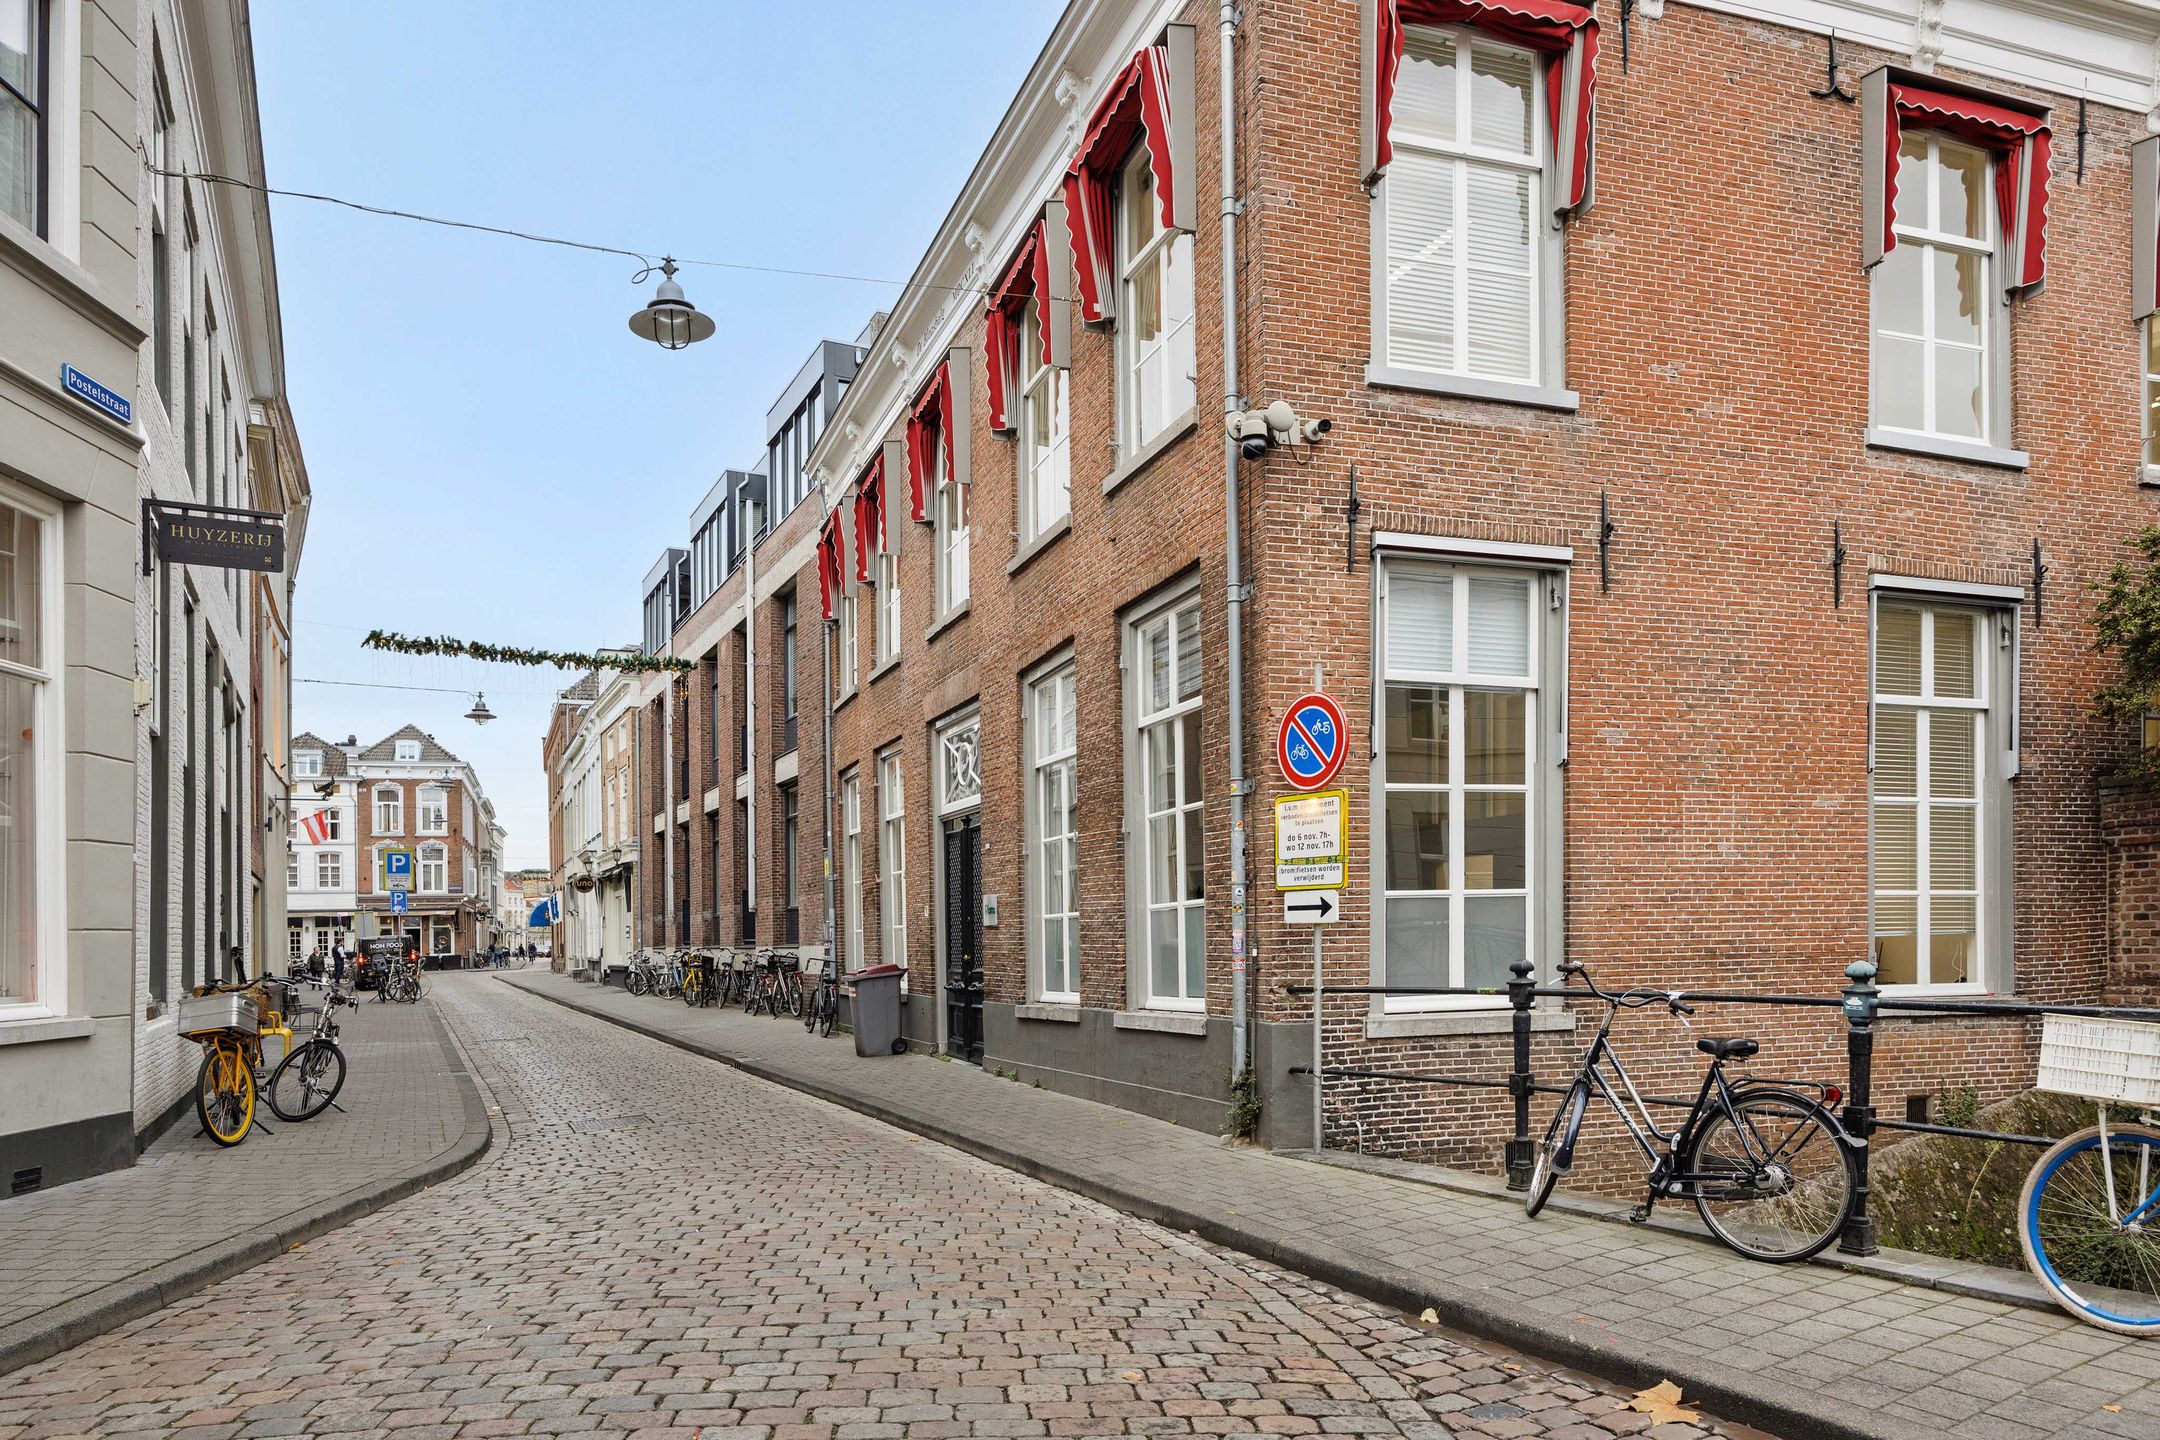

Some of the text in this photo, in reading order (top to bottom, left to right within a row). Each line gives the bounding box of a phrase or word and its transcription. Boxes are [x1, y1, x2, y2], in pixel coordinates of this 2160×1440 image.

[70, 372, 129, 416] Postelstraat
[171, 524, 272, 547] HUYZERIJ
[1287, 834, 1296, 842] do
[1297, 833, 1302, 841] 6
[1303, 833, 1318, 841] nov.
[1322, 840, 1334, 848] 17h
[392, 855, 406, 872] P
[1318, 864, 1340, 872] worden
[1294, 874, 1325, 882] verwijderd
[394, 893, 404, 905] P
